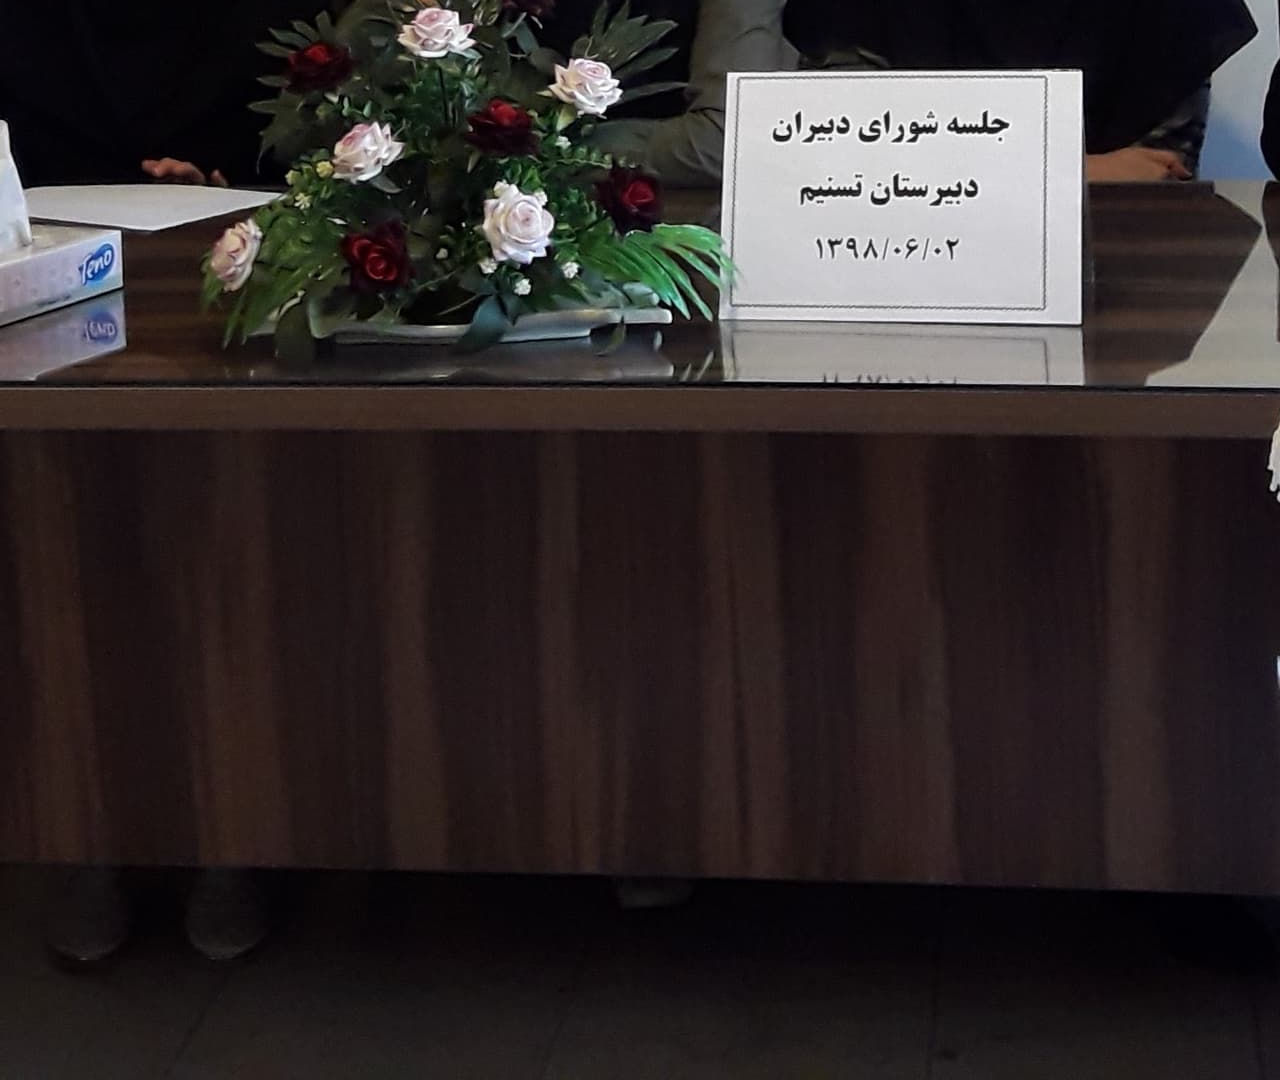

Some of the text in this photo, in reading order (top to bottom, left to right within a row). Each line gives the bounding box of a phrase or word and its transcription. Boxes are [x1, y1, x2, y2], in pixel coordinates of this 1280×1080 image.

[772, 110, 1010, 143] جلسه شورای دبیران
[800, 173, 978, 206] دبیرستان تسنیم
[816, 237, 959, 260] ۱۳۹۸/۰۶/۰۲
[79, 249, 113, 285] Teno
